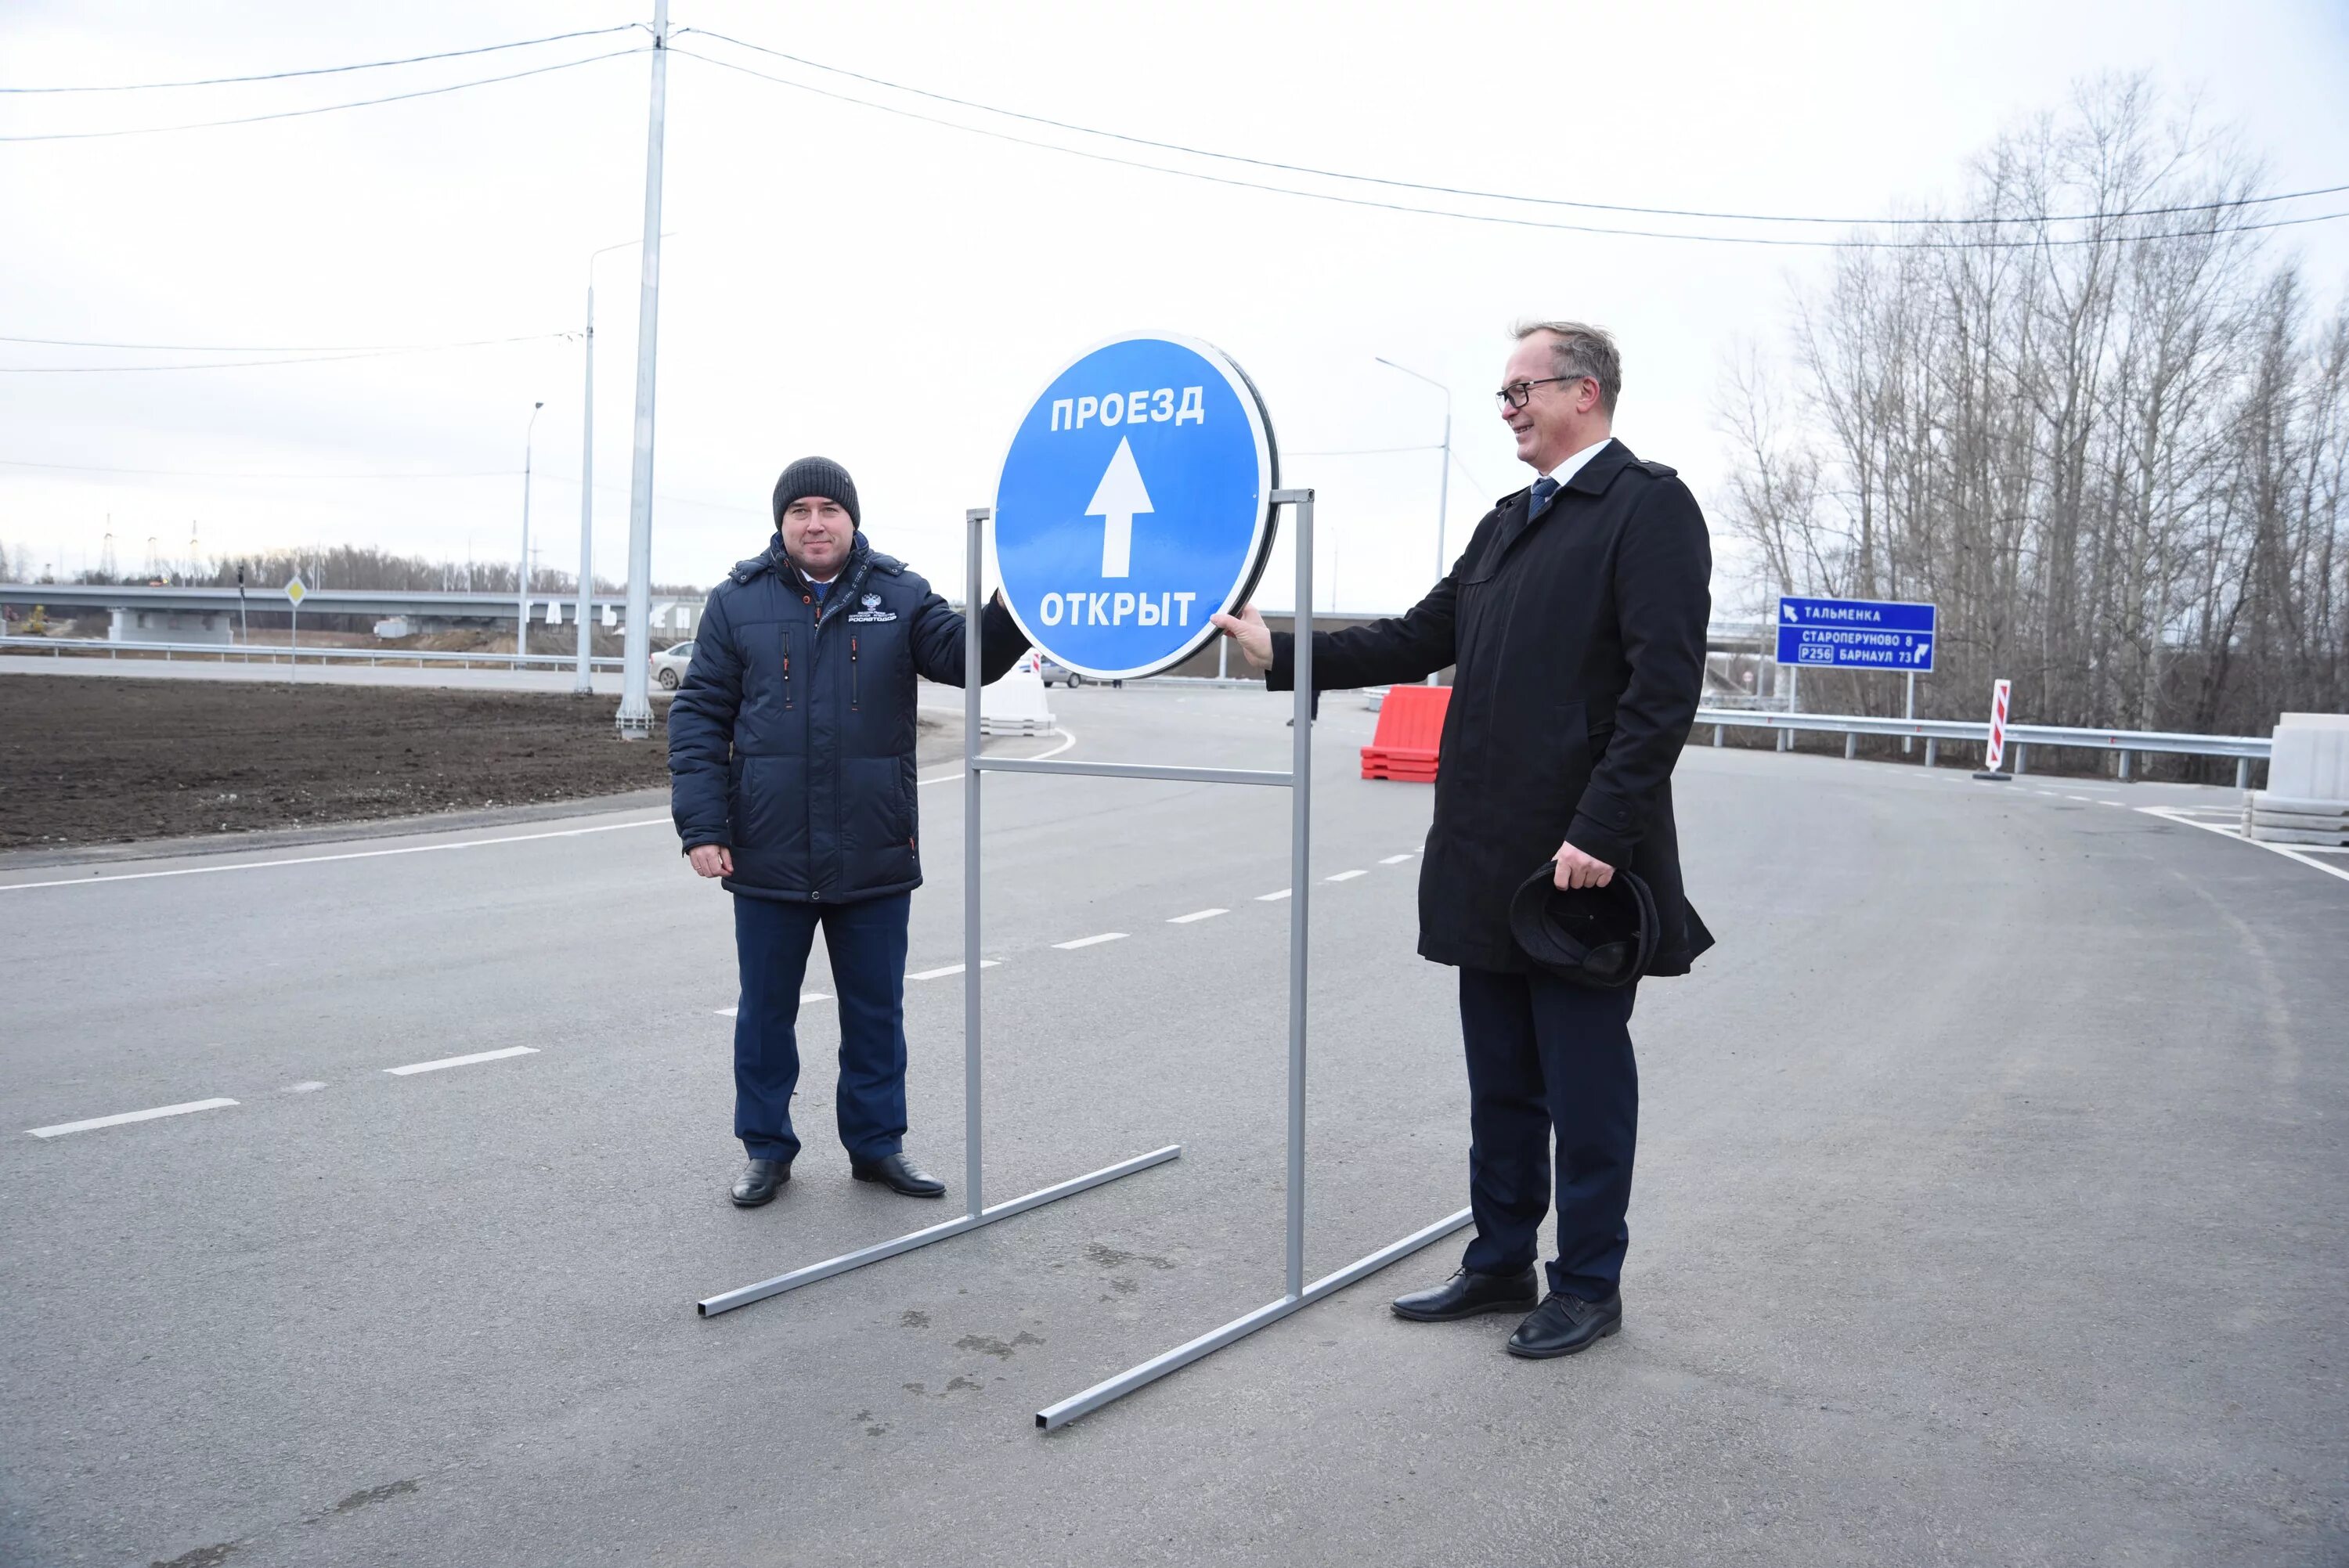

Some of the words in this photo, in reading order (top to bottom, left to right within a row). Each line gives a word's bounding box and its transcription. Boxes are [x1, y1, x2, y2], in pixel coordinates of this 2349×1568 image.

[1050, 386, 1205, 431] ПРОЕЗД
[1040, 592, 1196, 626] ОТКРЫТ
[1804, 606, 1881, 622] ТАЛЬМЕНКА
[1802, 630, 1900, 647] СТАРОПЕРУНОВО
[1905, 635, 1913, 647] 8
[1801, 647, 1832, 660] Р256
[1839, 648, 1893, 662] БАРНАУЛ
[1899, 651, 1911, 663] 73
